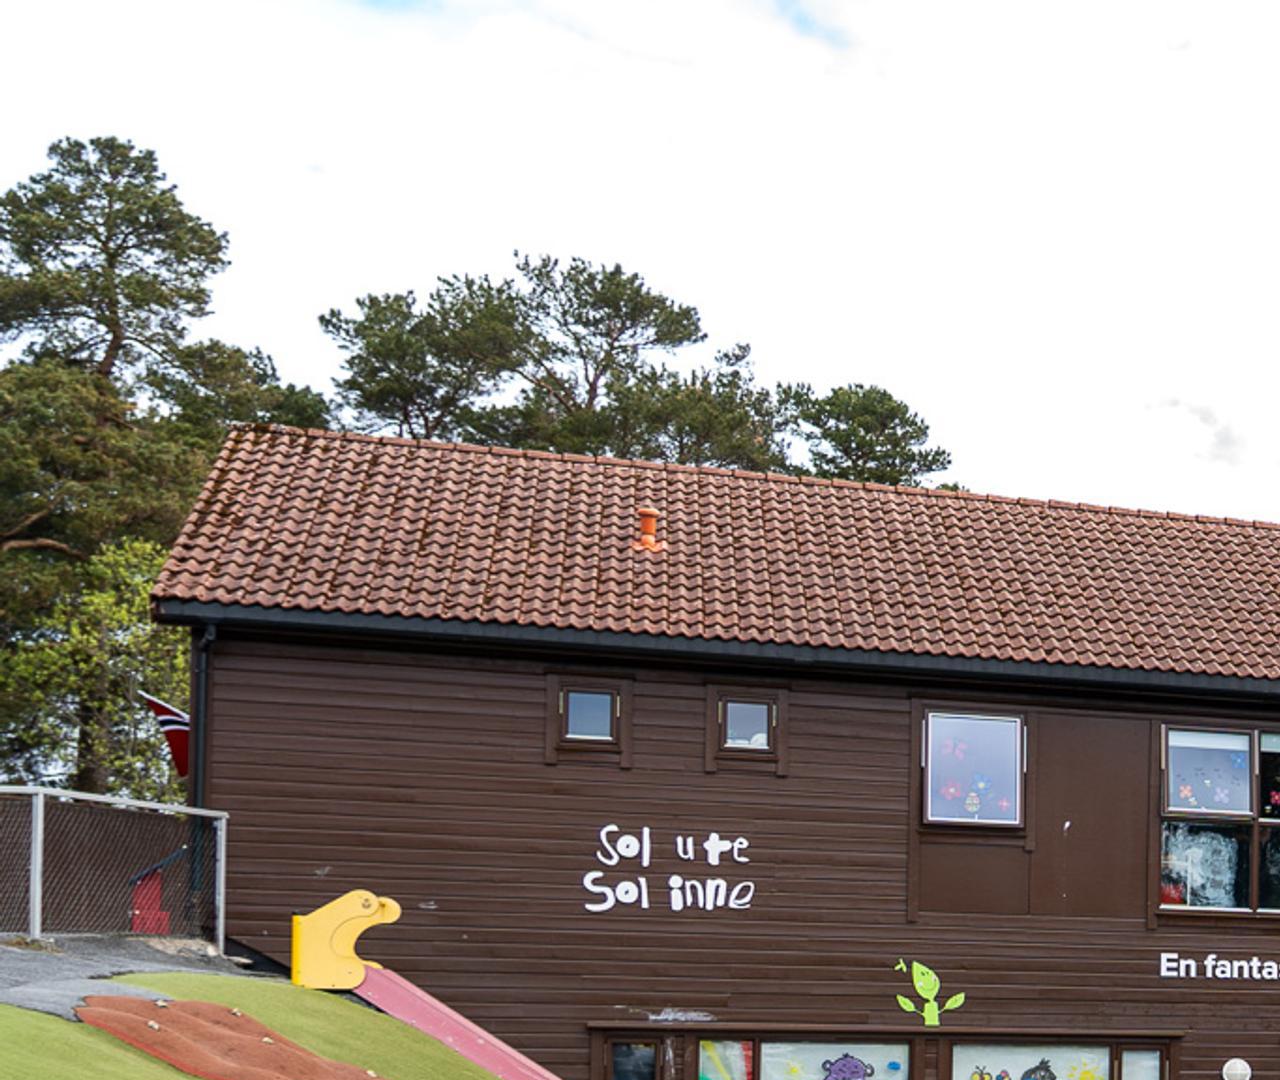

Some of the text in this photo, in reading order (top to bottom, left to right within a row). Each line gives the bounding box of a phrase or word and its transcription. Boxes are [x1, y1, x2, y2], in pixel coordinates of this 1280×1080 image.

[597, 825, 749, 867] Sol ute
[584, 871, 754, 911] Sol inne
[1160, 952, 1197, 978] En
